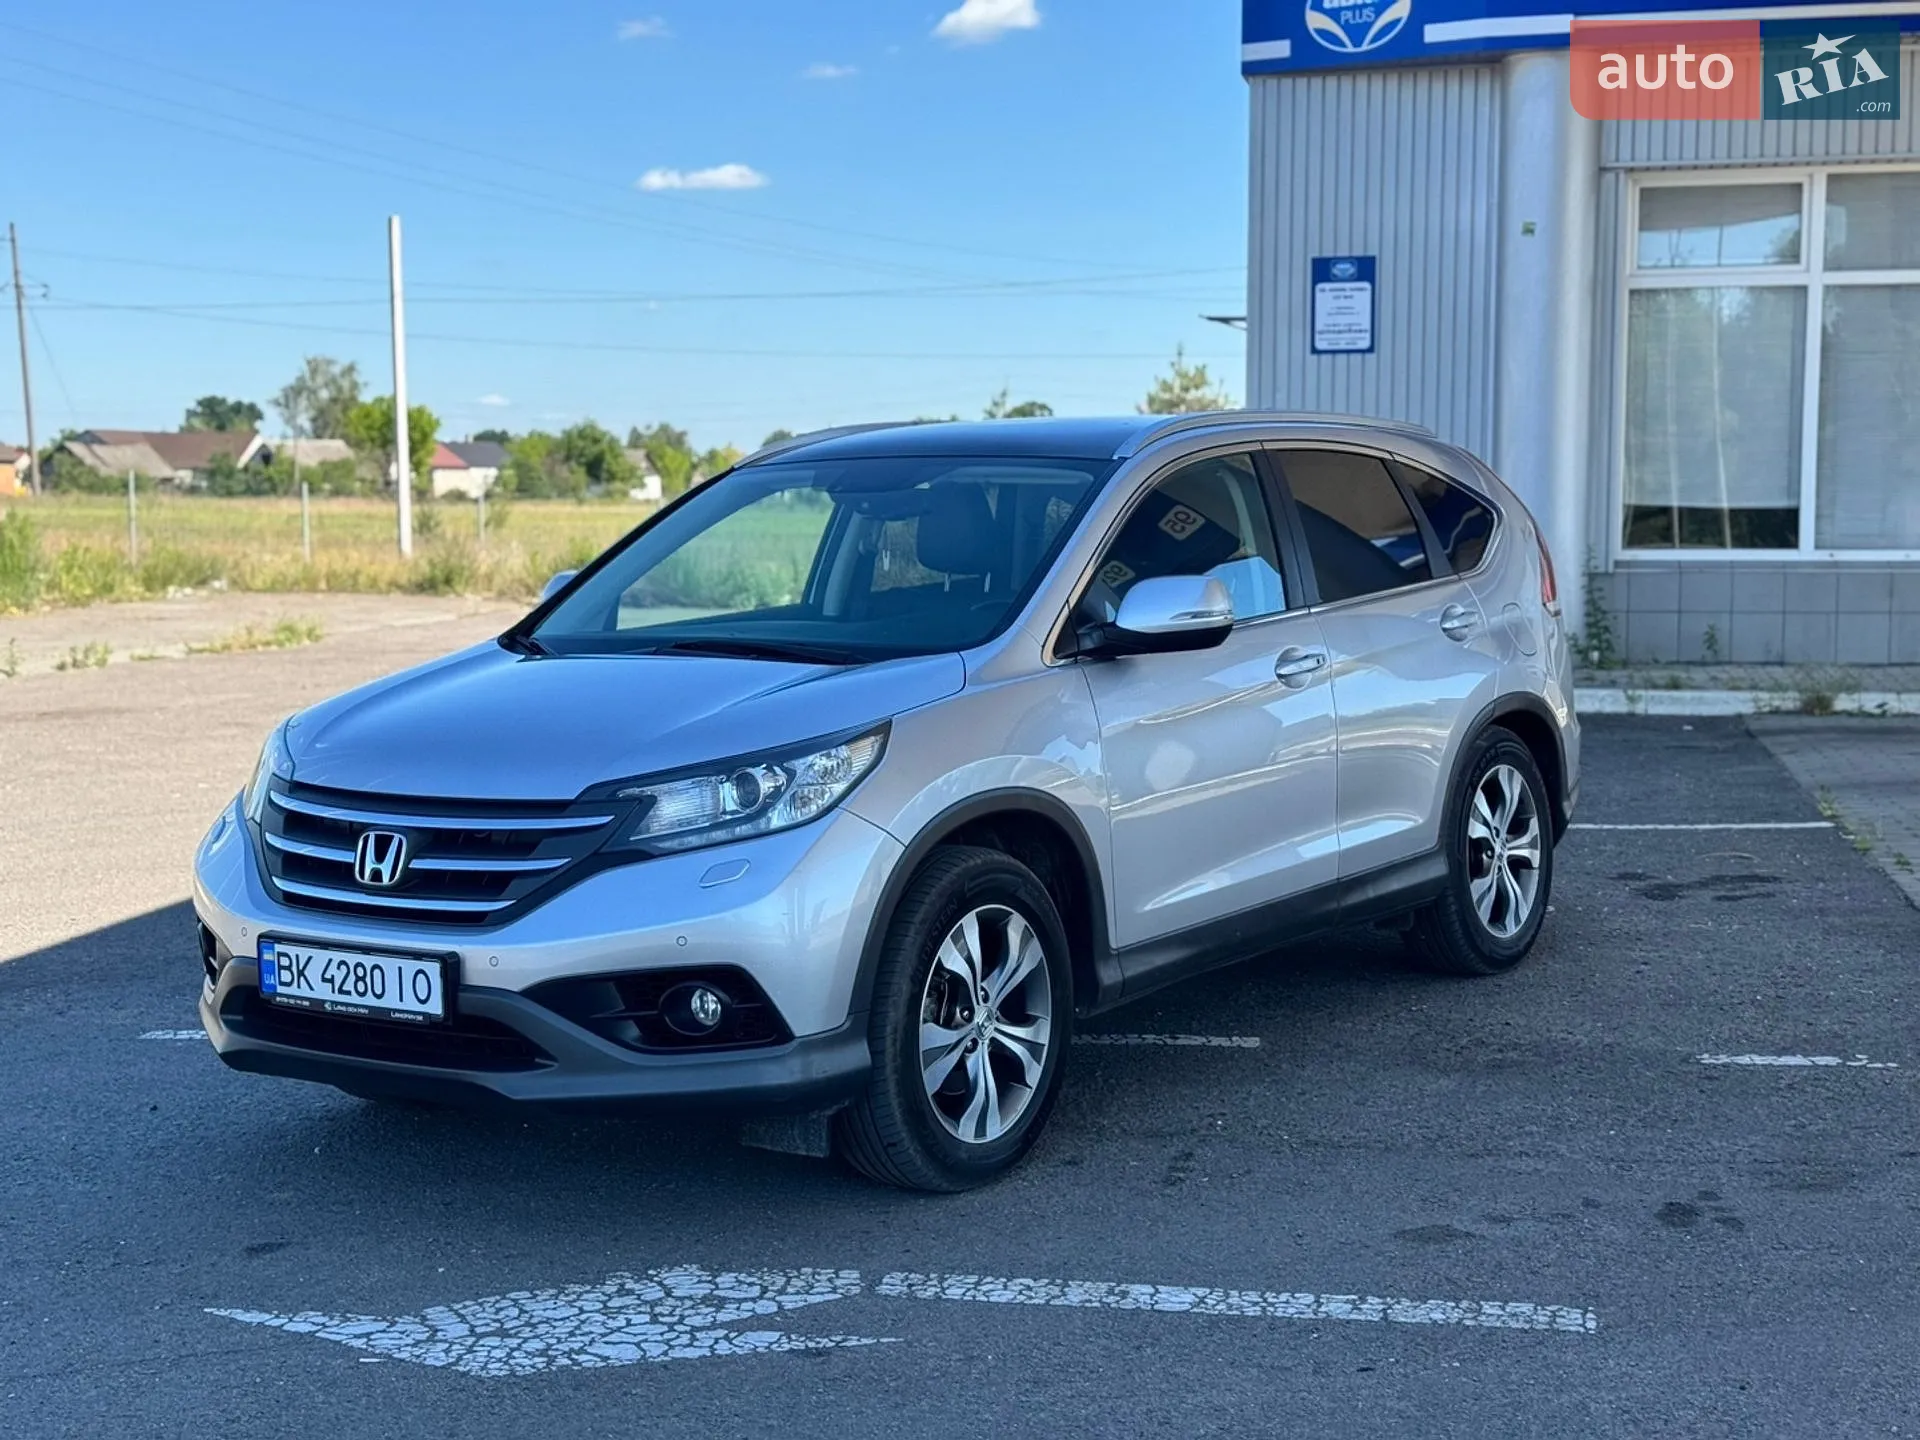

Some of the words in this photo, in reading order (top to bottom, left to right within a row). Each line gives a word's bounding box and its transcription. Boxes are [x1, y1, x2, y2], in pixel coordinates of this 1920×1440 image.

[1340, 6, 1376, 25] PLUS
[263, 973, 276, 985] UA
[276, 950, 316, 992] BK
[320, 957, 386, 1000] 4280
[397, 965, 432, 1006] IO
